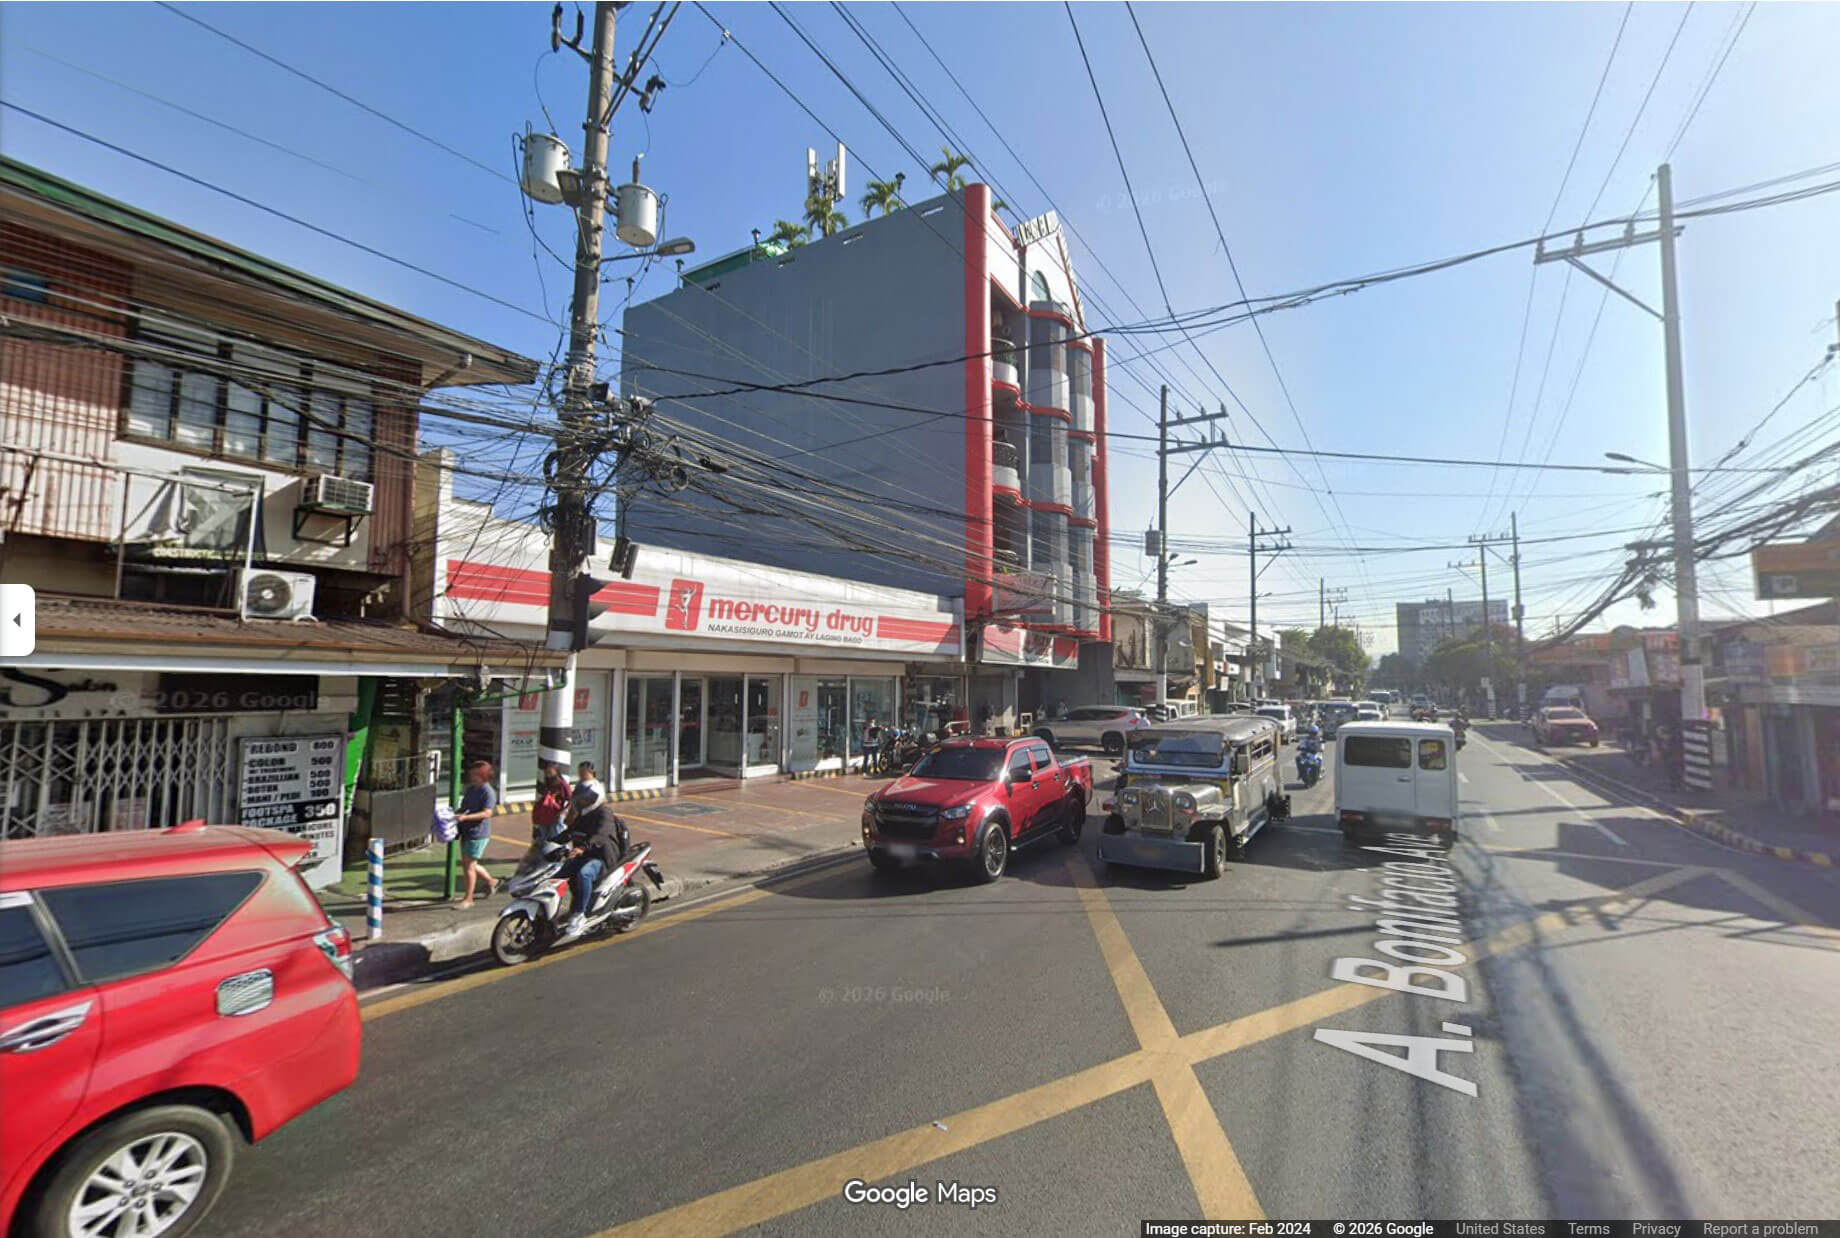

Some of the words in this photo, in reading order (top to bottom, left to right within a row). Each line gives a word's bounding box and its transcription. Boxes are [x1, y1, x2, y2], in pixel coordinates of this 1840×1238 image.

[708, 598, 820, 633] mercury
[826, 608, 874, 638] drug
[248, 758, 285, 767] COLOR
[304, 803, 336, 818] 350
